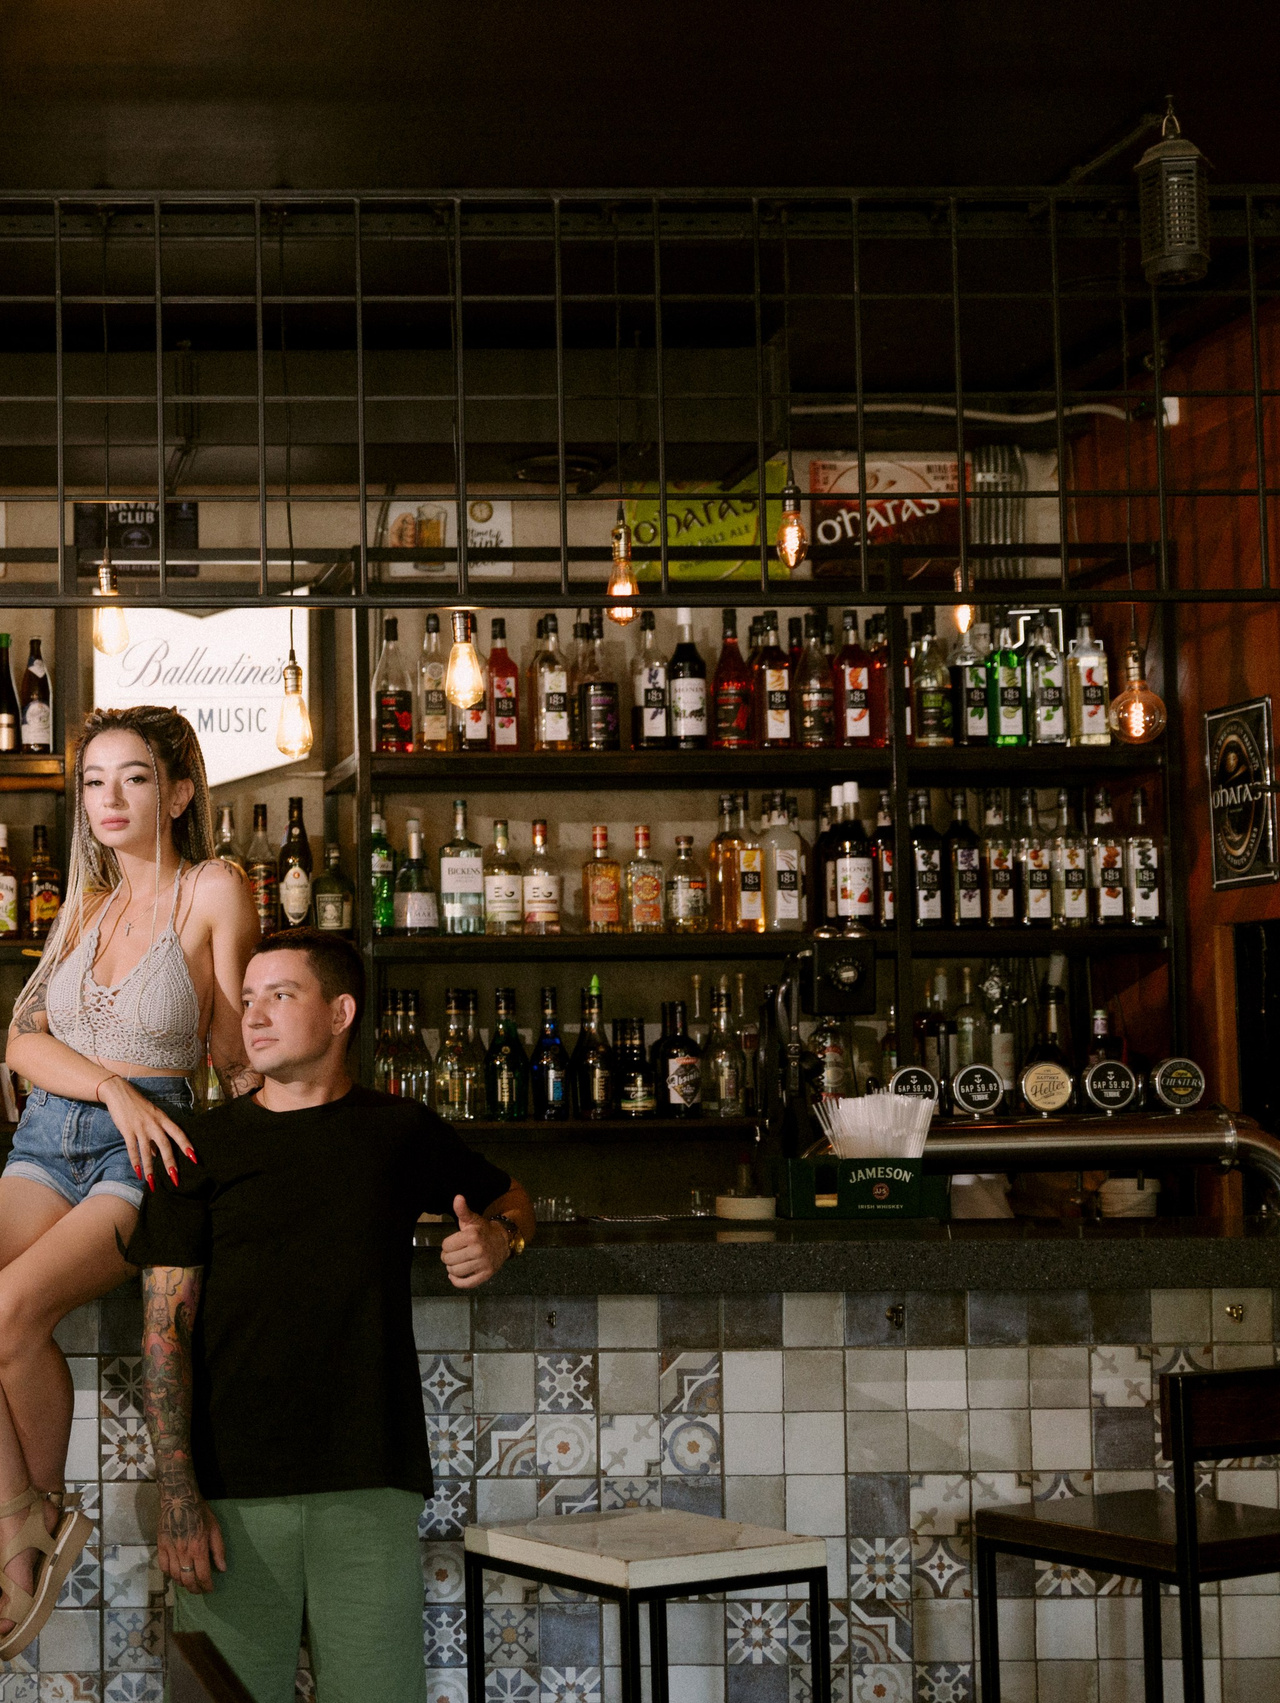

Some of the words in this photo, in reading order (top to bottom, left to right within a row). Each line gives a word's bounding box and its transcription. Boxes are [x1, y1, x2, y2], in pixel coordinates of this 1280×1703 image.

[118, 511, 155, 524] CLUB
[118, 637, 288, 688] Ballantine's
[197, 707, 268, 733] MUSIC
[447, 867, 481, 875] BICKENS
[897, 1084, 911, 1093] БАР
[960, 1085, 975, 1093] БАР
[1030, 1081, 1065, 1098] Helles
[1092, 1080, 1107, 1089] БАР
[849, 1167, 912, 1183] JAMESON
